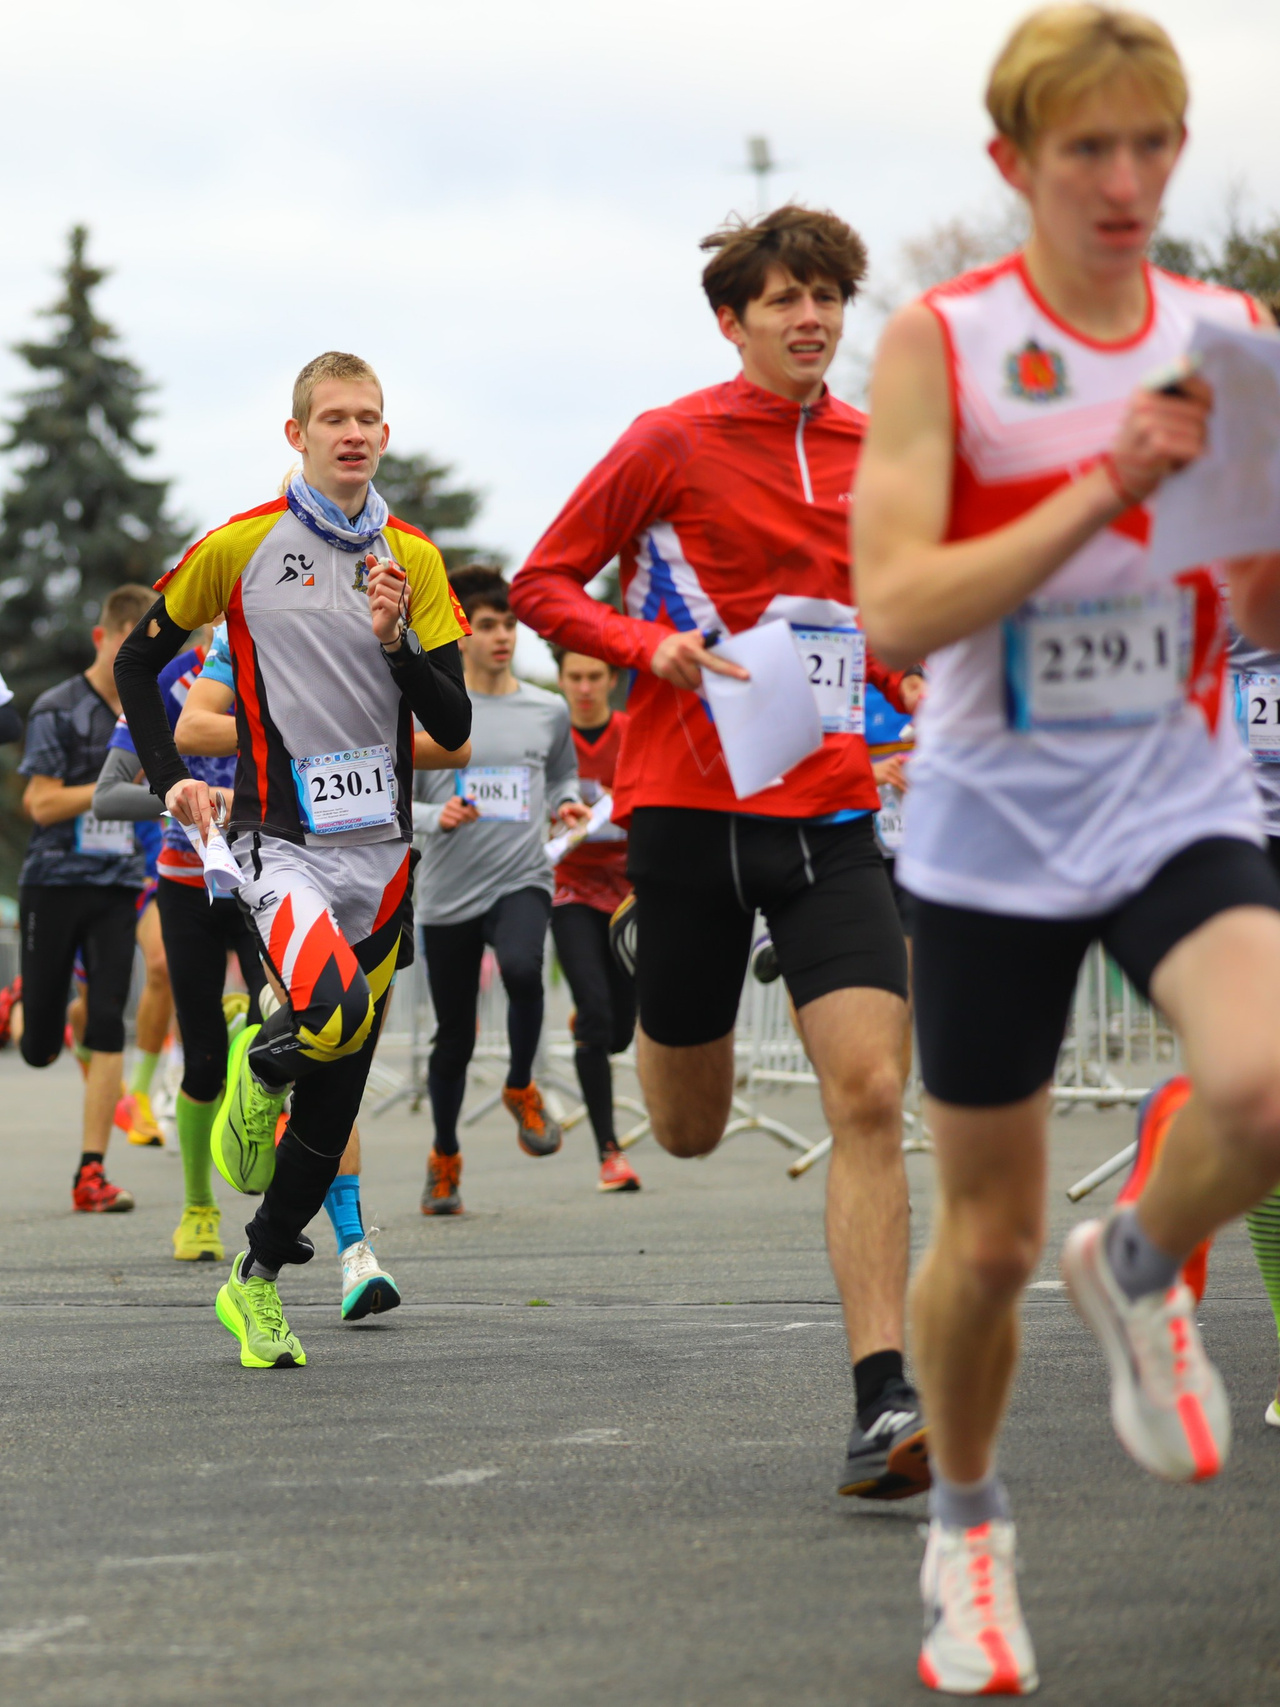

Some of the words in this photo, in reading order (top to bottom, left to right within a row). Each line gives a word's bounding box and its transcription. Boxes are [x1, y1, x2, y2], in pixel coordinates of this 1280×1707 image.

[806, 653, 845, 688] 2.1
[1039, 625, 1169, 684] 229.1
[1250, 697, 1280, 725] 21
[310, 767, 385, 803] 230.1
[469, 782, 517, 800] 208.1
